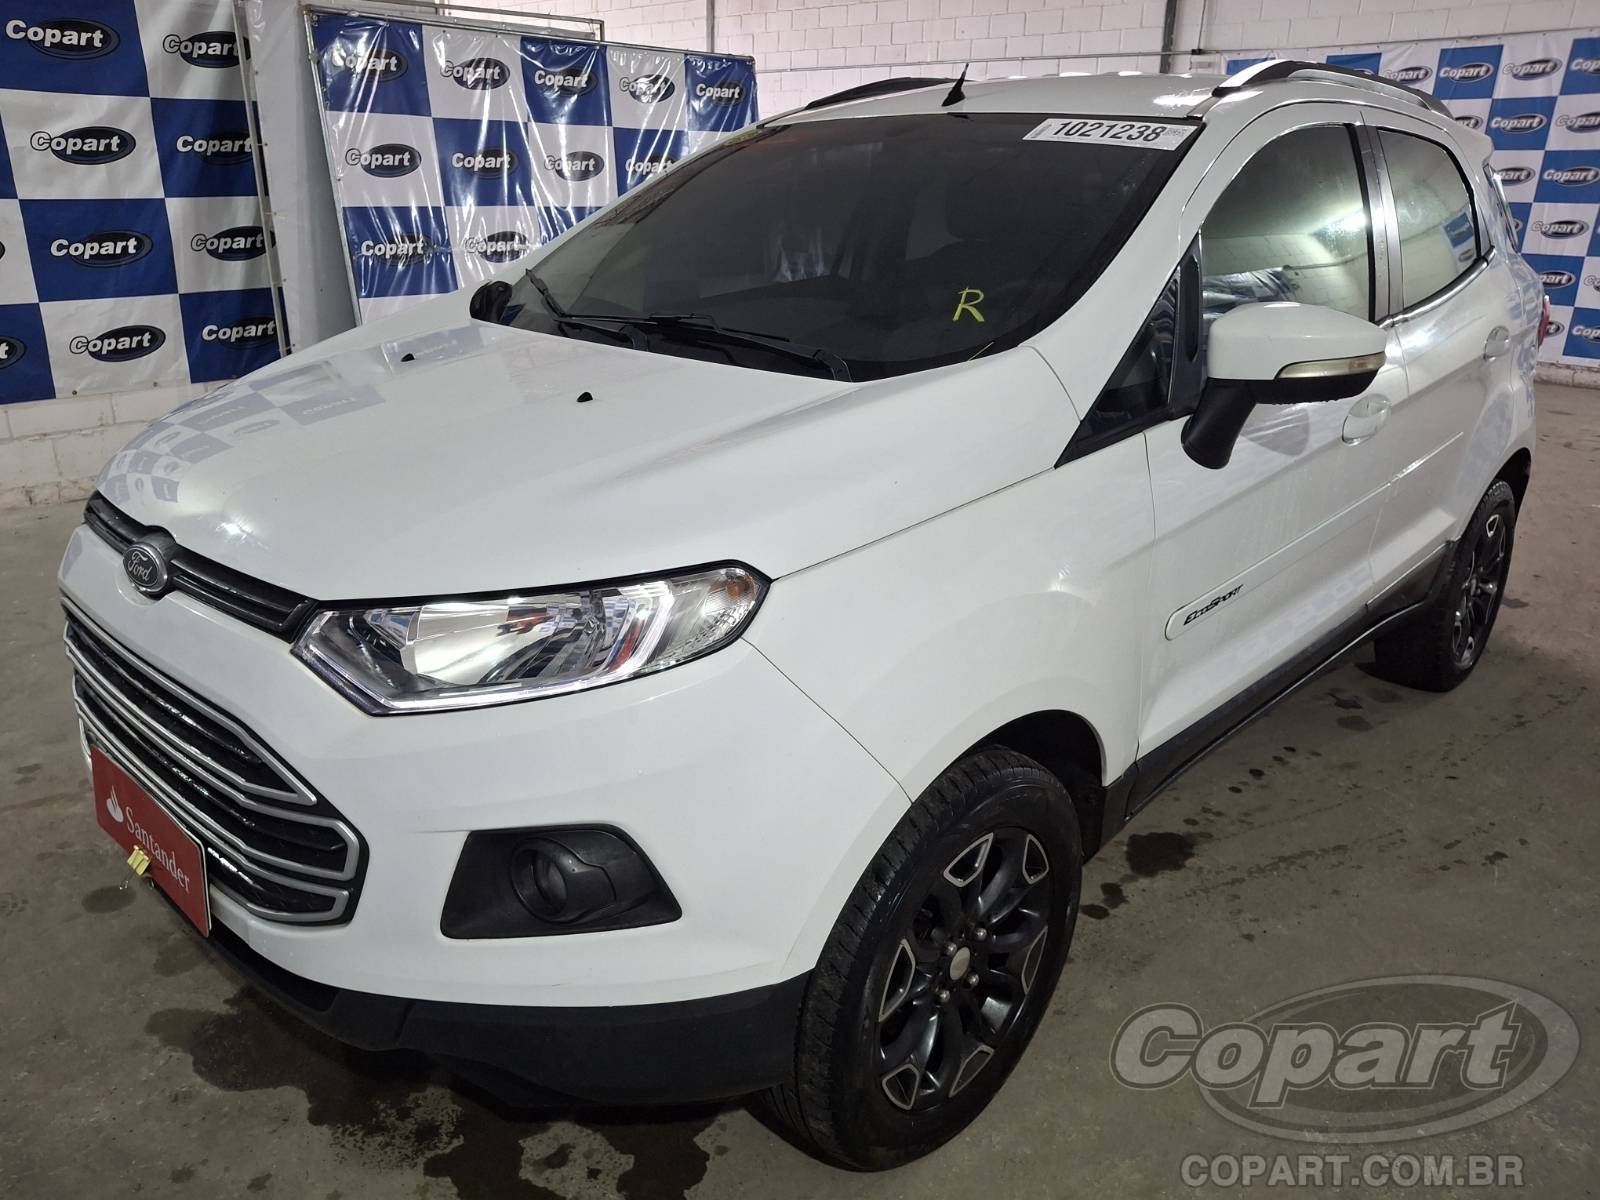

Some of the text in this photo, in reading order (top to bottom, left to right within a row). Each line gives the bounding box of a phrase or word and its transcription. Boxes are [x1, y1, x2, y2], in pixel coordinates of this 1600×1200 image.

[5, 19, 103, 47] Copart
[441, 60, 501, 82] Copart
[1440, 65, 1489, 81] Copart
[1503, 59, 1553, 77] Copart
[1570, 58, 1600, 73] Cop
[534, 70, 588, 88] Copart
[696, 83, 741, 99] Copart
[1053, 121, 1167, 142] 1021238
[1490, 115, 1541, 132] Copart
[1556, 114, 1600, 129] Copar
[31, 132, 121, 154] Copart
[176, 135, 253, 156] Copart
[345, 148, 411, 169] Copart
[452, 152, 512, 171] Copart
[545, 155, 596, 175] Copart
[1543, 169, 1595, 182] Copart
[1531, 221, 1581, 234] Copart
[50, 237, 138, 260] Copart
[191, 232, 265, 252] Copart
[361, 239, 424, 258] Copart
[952, 286, 985, 322] R
[201, 319, 276, 342] Copart
[1571, 325, 1600, 338] Cop
[70, 330, 152, 355] Copart
[127, 551, 153, 582] Ford
[125, 806, 190, 894] Santander
